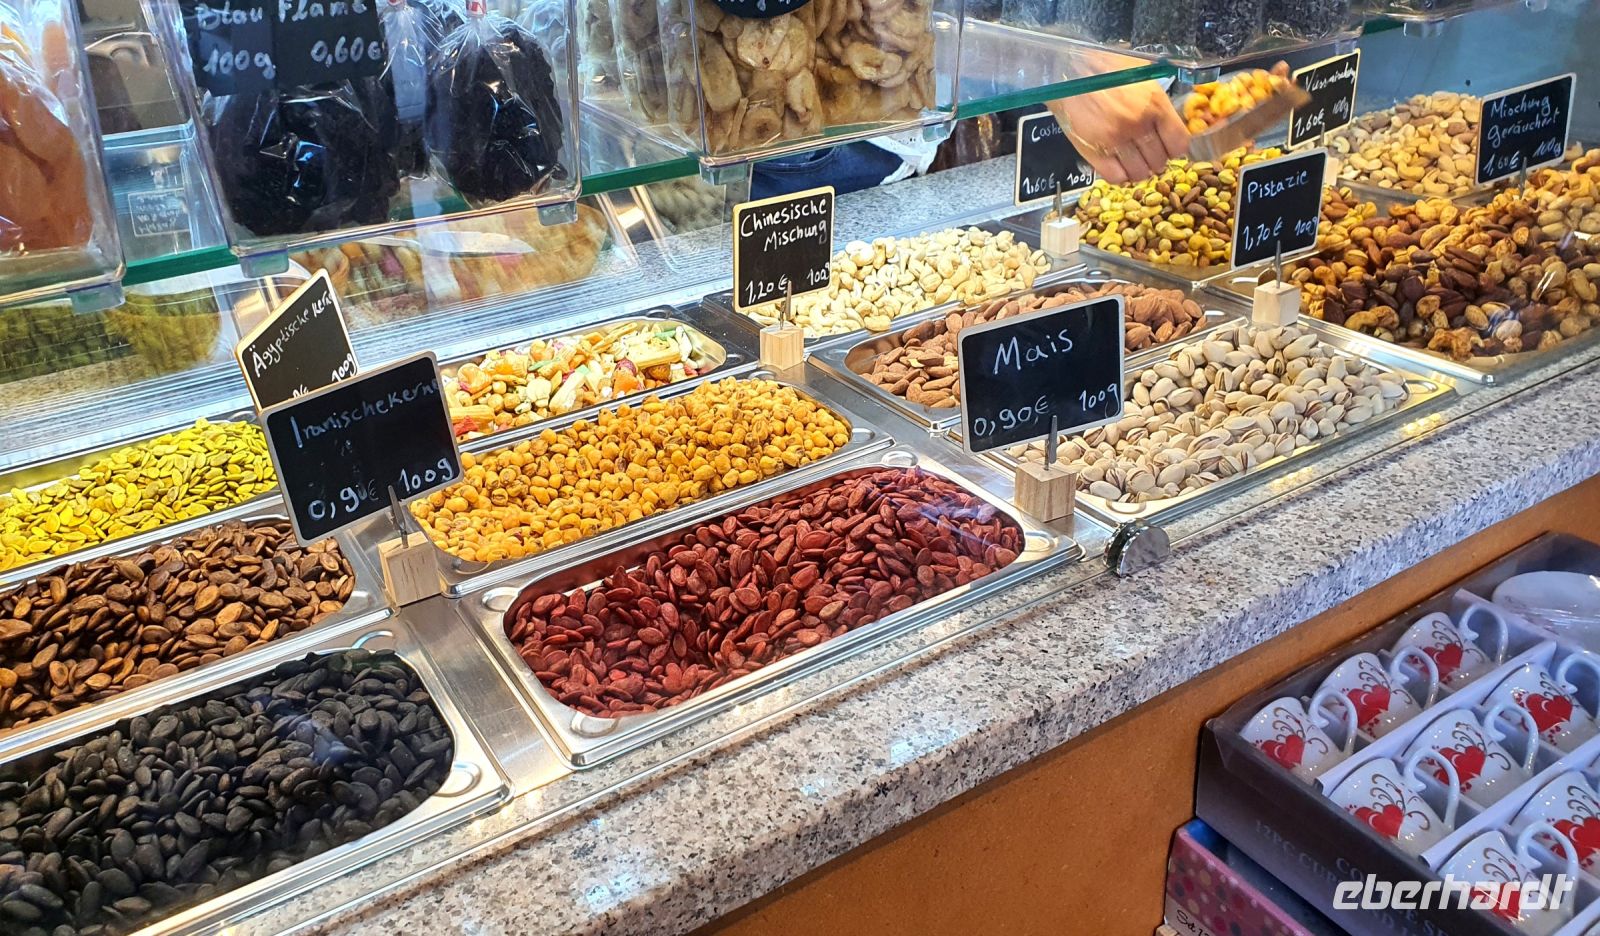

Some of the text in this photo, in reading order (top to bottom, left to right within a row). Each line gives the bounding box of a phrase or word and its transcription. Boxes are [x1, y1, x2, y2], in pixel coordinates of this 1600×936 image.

[203, 49, 276, 80] 100g
[1248, 170, 1308, 203] Pistazie
[741, 198, 827, 237] Chinesische
[764, 220, 827, 252] Mischung
[249, 309, 309, 378] Ägyptische
[993, 329, 1073, 375] Mais
[1079, 383, 1120, 418] 100g
[400, 457, 453, 493] 100g
